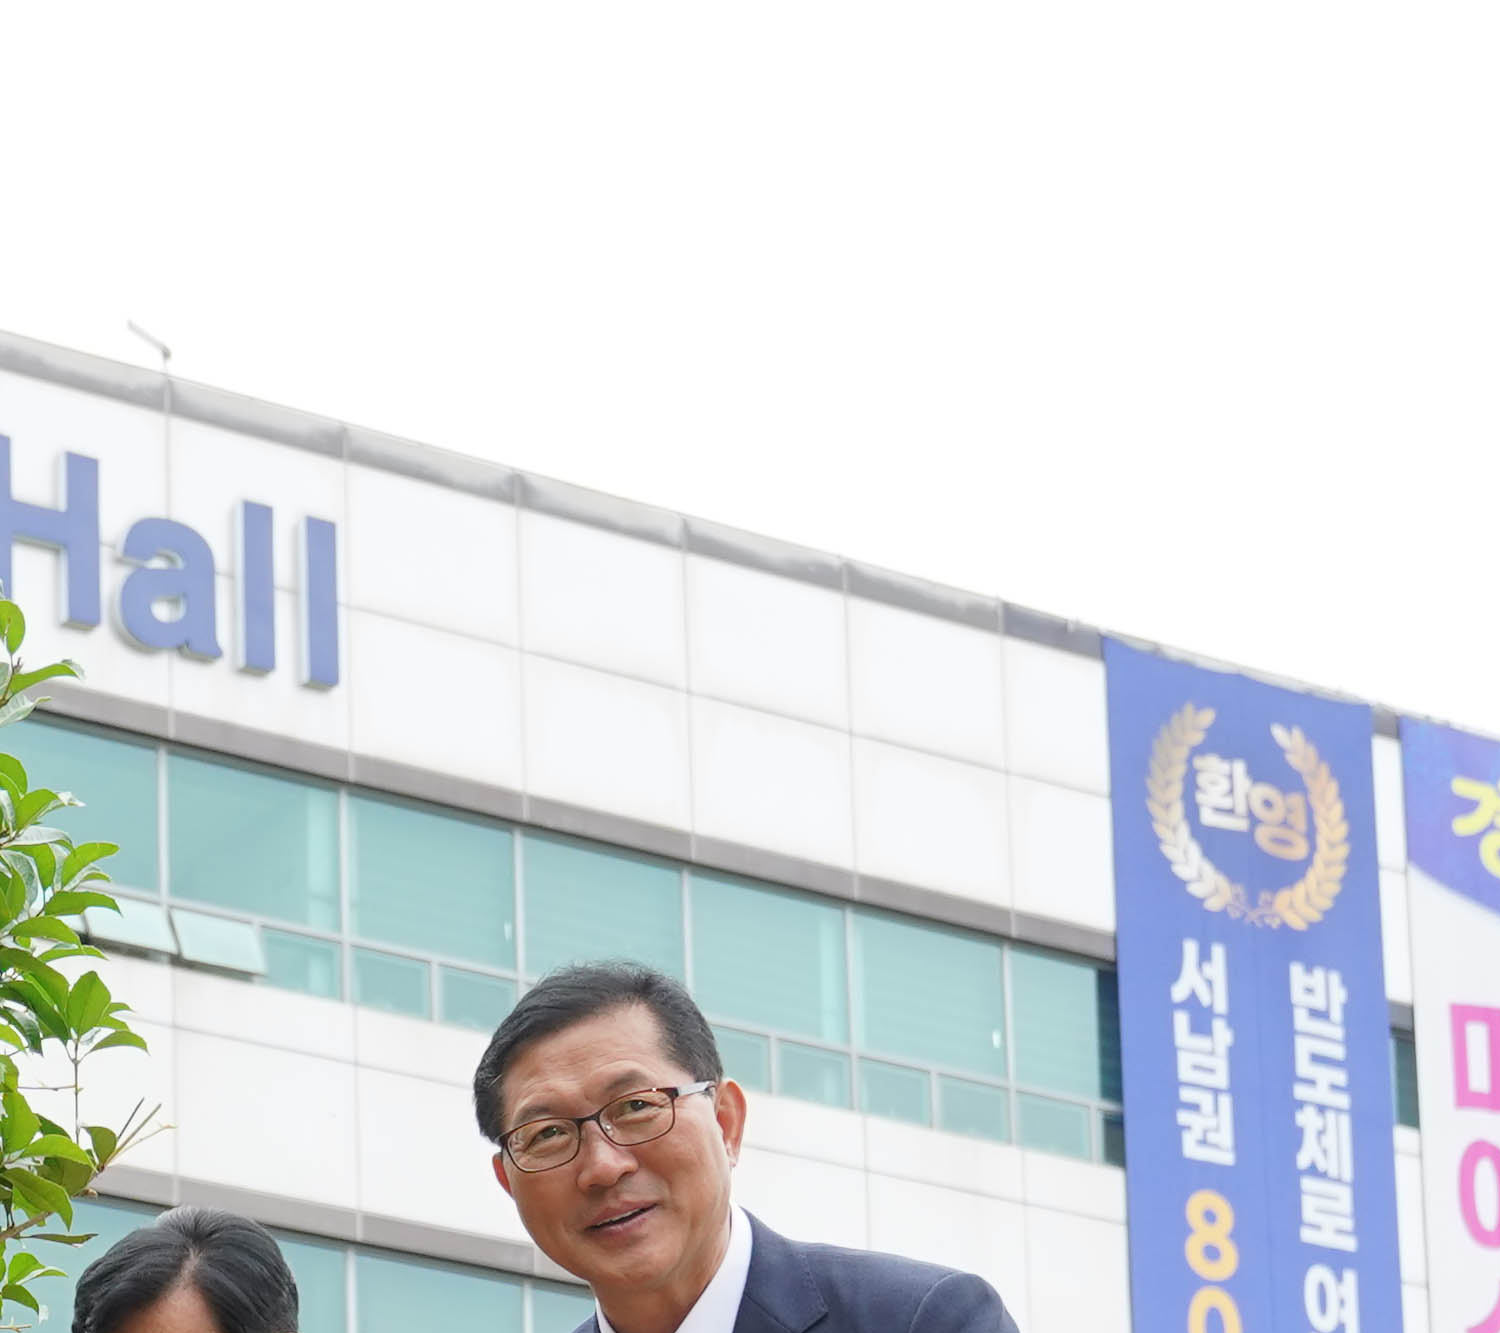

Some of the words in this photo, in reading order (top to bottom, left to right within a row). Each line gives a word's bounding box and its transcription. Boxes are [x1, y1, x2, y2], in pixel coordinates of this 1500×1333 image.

[1191, 751, 1310, 862] 환영
[1170, 937, 1237, 1167] 서남권
[1288, 960, 1358, 1254] 반도체로
